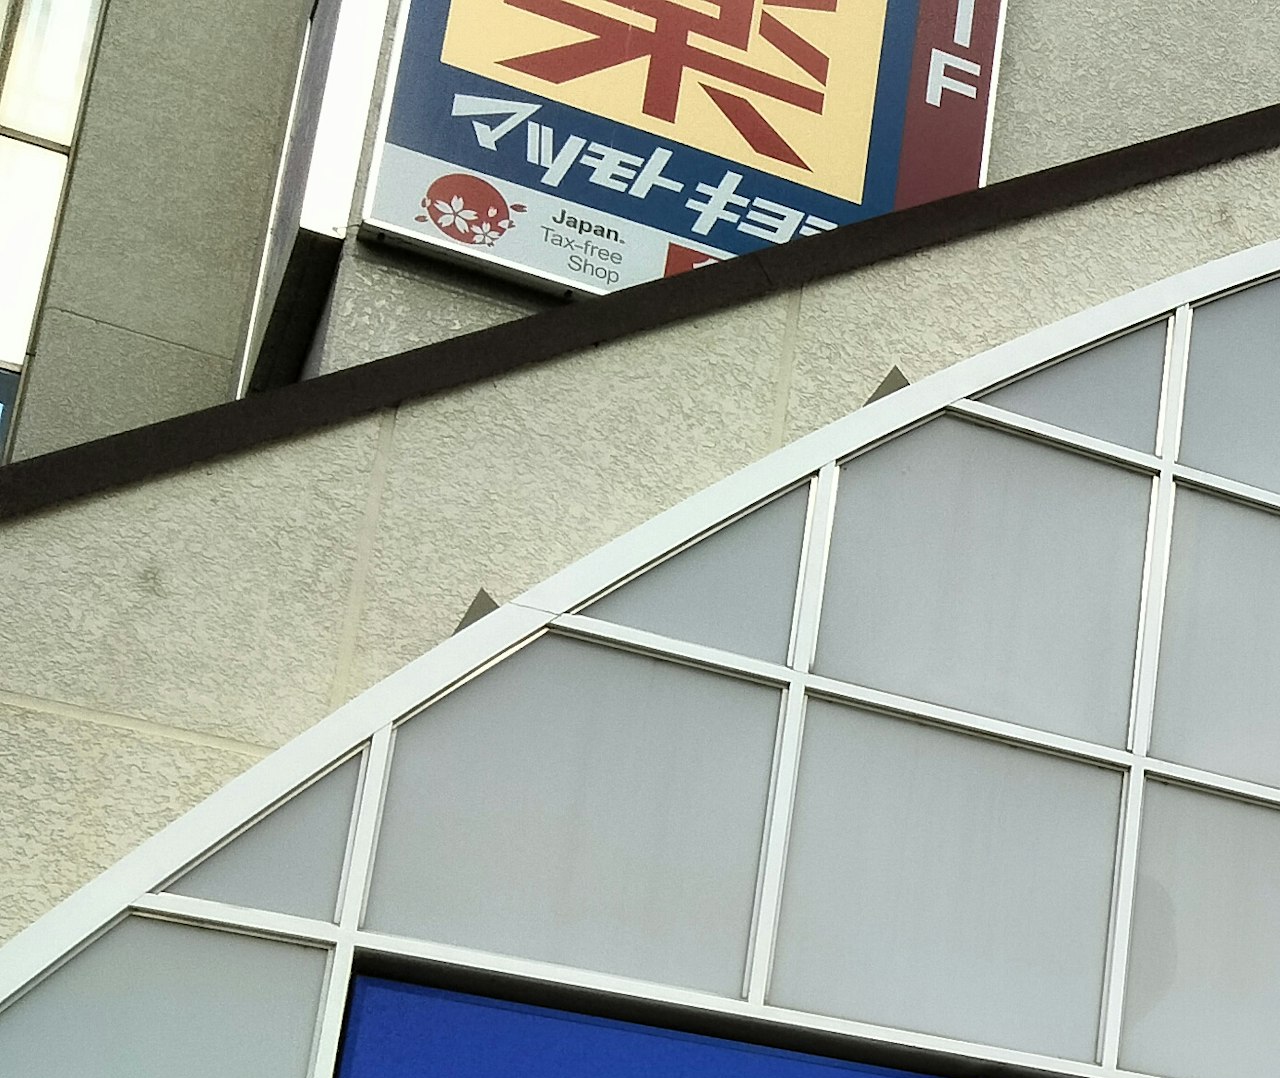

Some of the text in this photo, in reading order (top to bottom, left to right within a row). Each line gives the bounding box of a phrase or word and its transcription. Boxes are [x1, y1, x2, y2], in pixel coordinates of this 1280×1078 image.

[451, 93, 838, 244] マツモトキヨ
[540, 227, 623, 265] Tax-free
[568, 254, 620, 284] Shop
